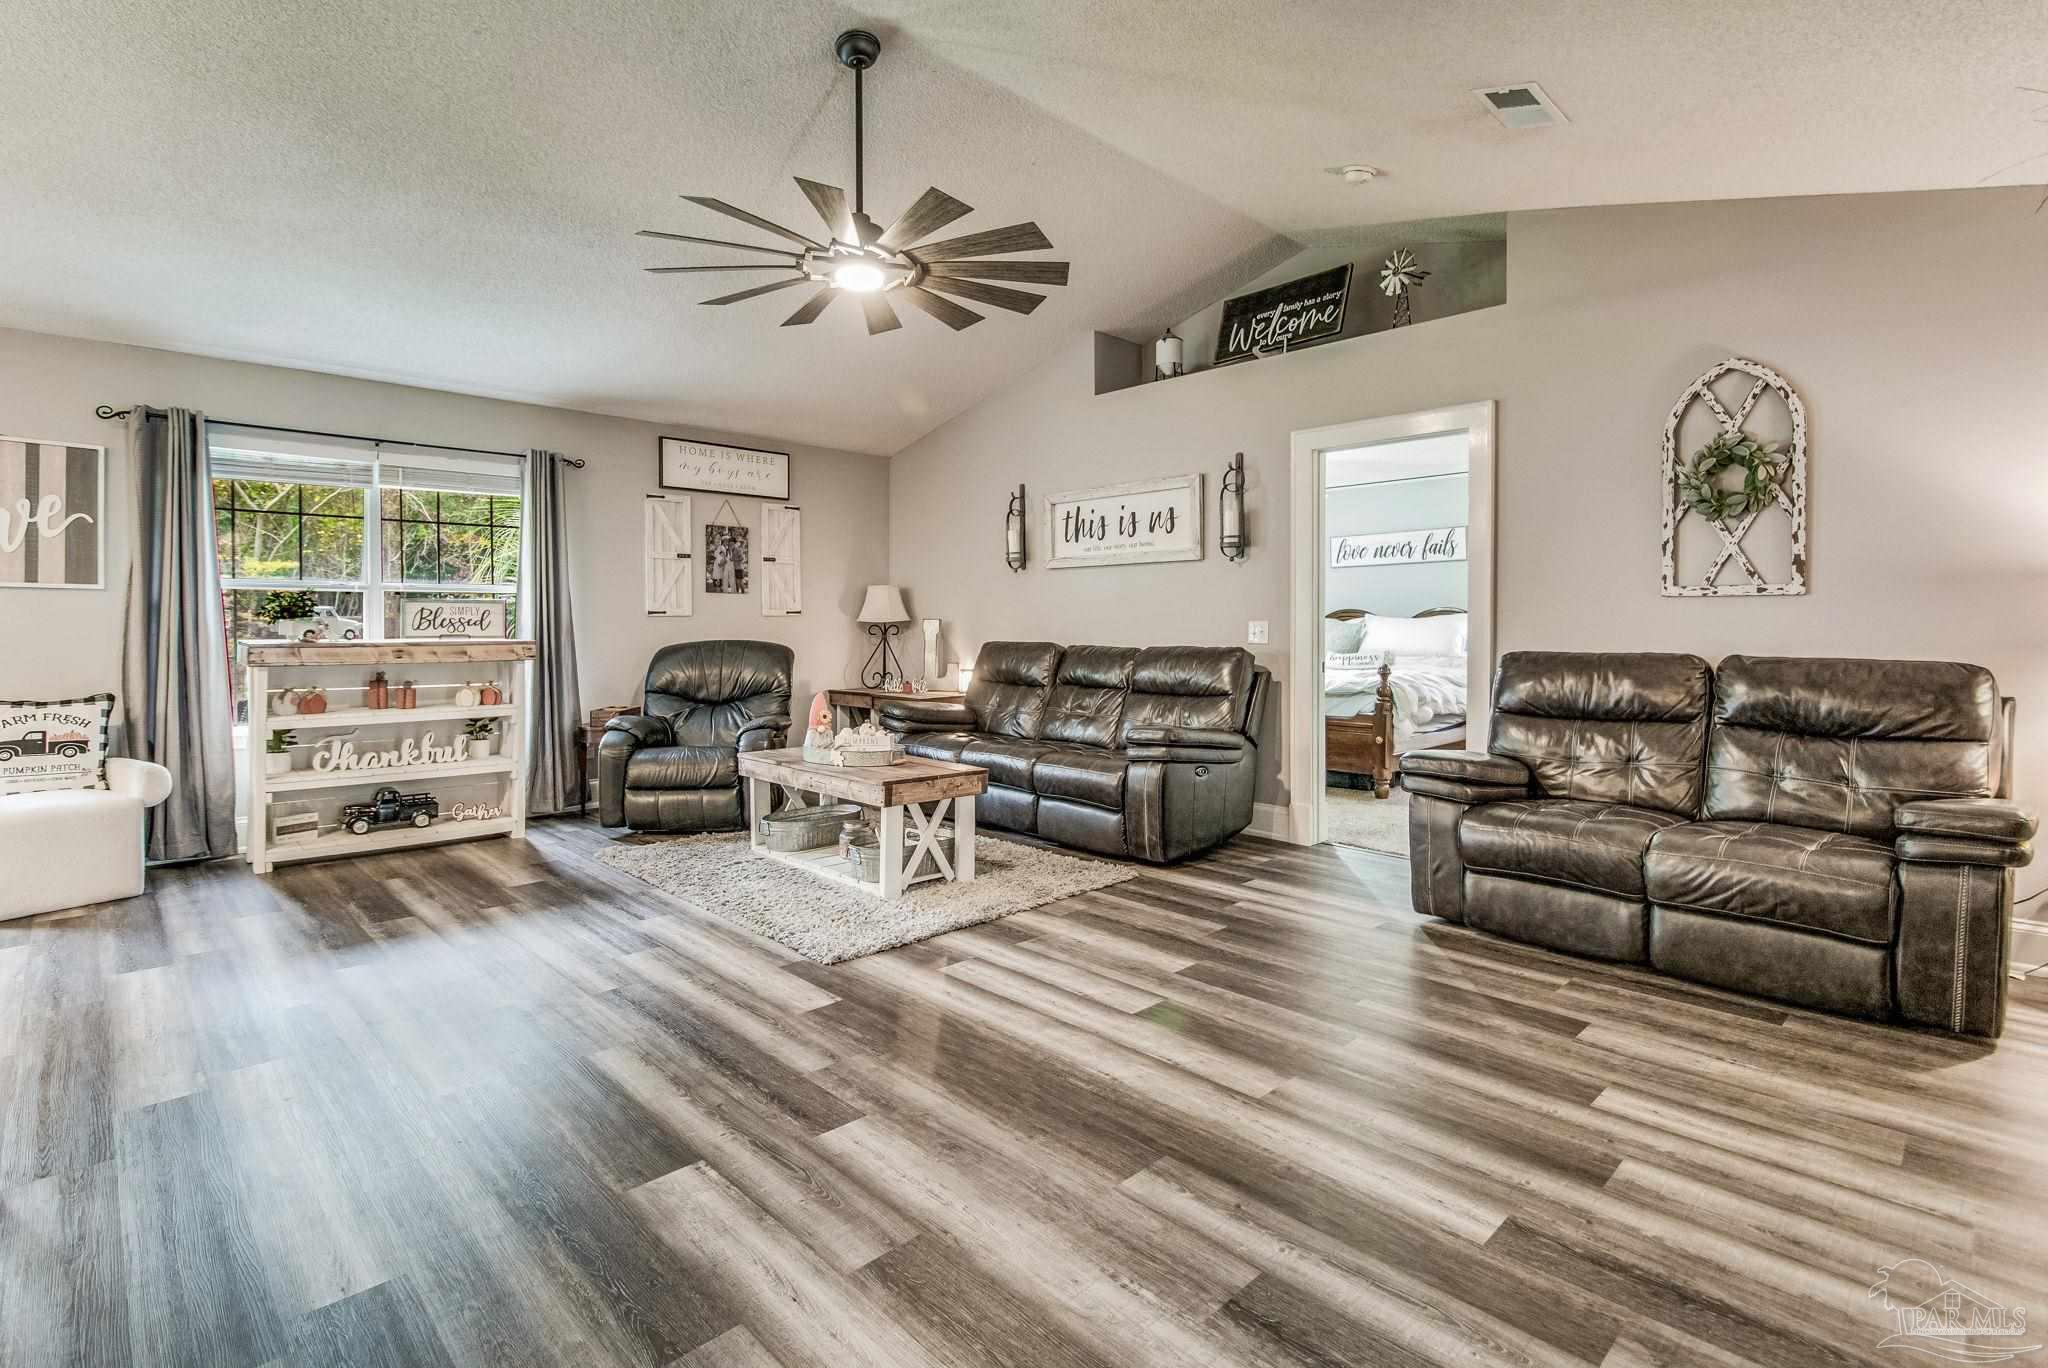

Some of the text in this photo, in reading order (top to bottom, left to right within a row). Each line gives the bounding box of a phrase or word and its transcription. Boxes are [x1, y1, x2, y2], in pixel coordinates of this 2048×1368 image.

[1229, 302, 1340, 352] Welcome
[679, 446, 776, 466] HOME IS WHERE
[0, 494, 94, 553] ve
[1062, 504, 1183, 543] this is us
[1336, 528, 1459, 564] love never fails
[412, 607, 491, 633] Blessed
[449, 606, 480, 616] SIMPLY
[0, 712, 92, 729] ARM FRESH
[313, 729, 470, 773] Thankful
[3, 763, 81, 776] PUMPKIN PATCH
[452, 802, 503, 822] Gather
